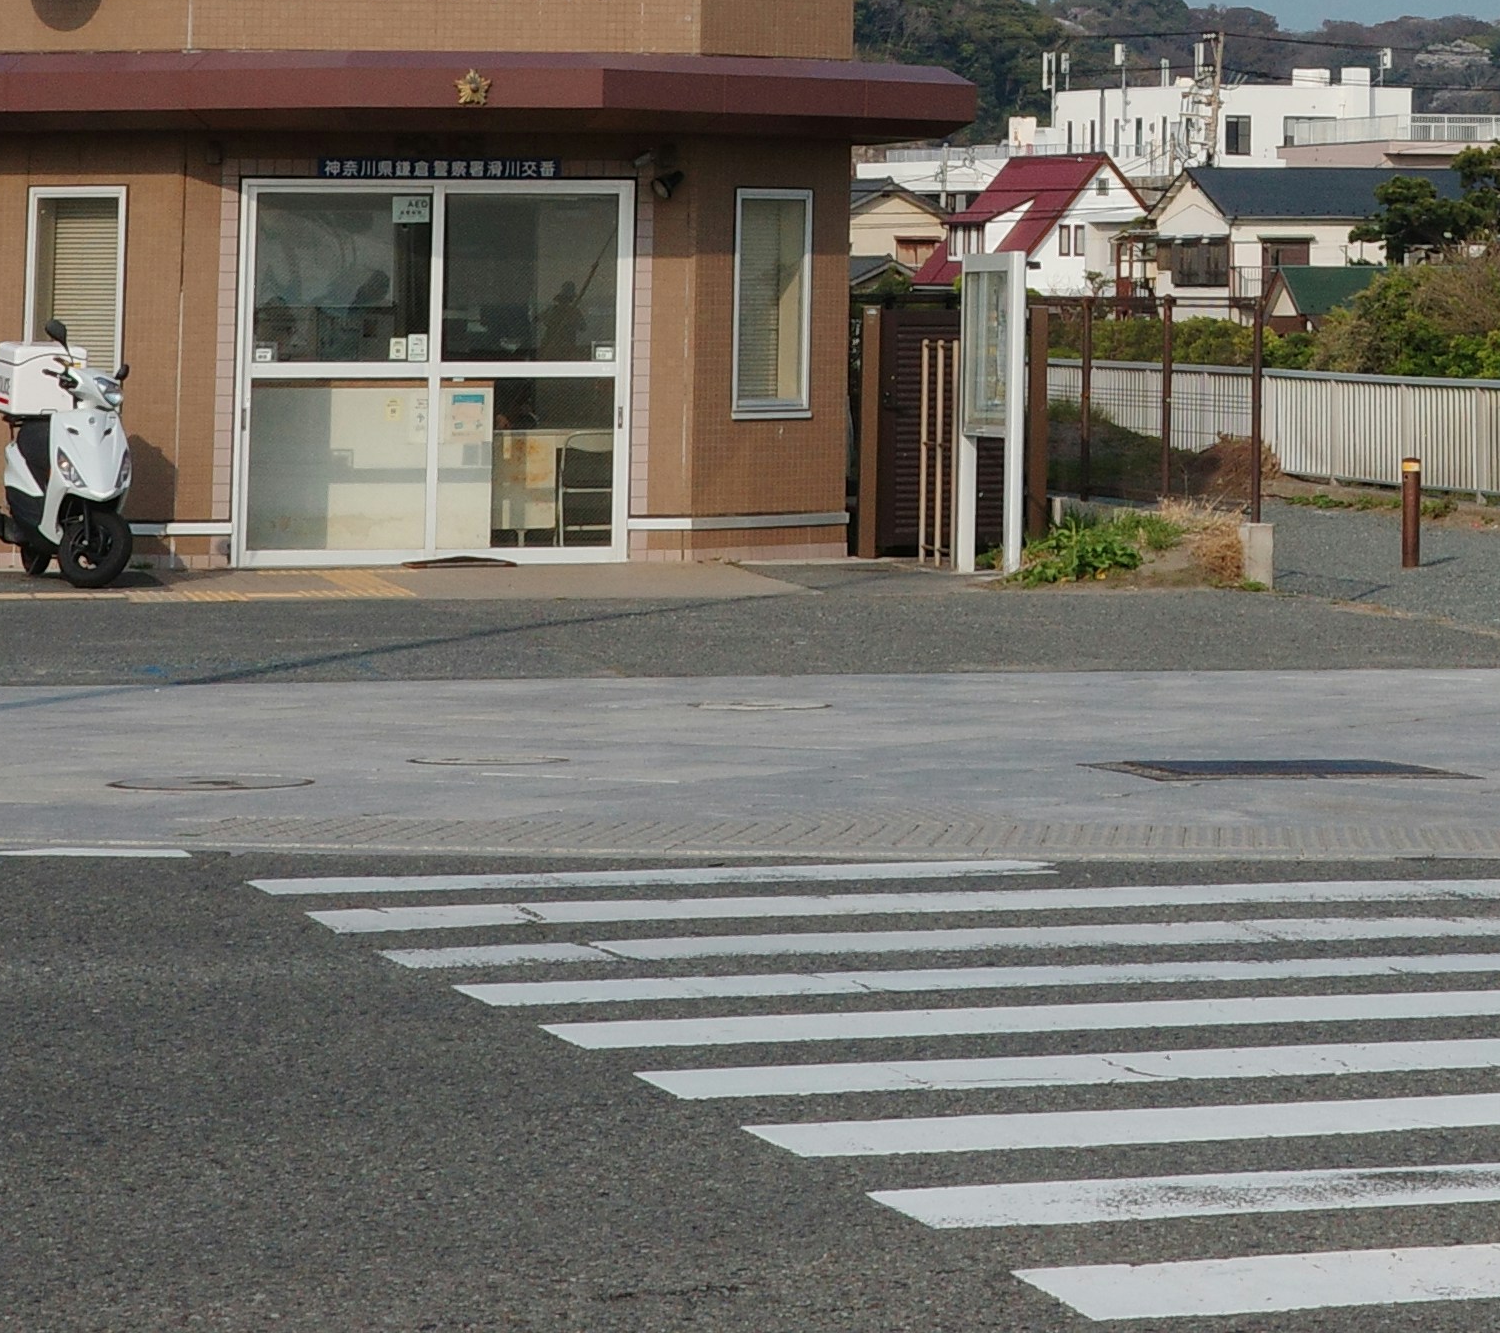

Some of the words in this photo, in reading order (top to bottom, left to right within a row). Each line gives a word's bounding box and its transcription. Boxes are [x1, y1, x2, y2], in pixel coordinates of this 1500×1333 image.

[323, 159, 557, 178] 神奈川県鎌倉警察署滑川交番
